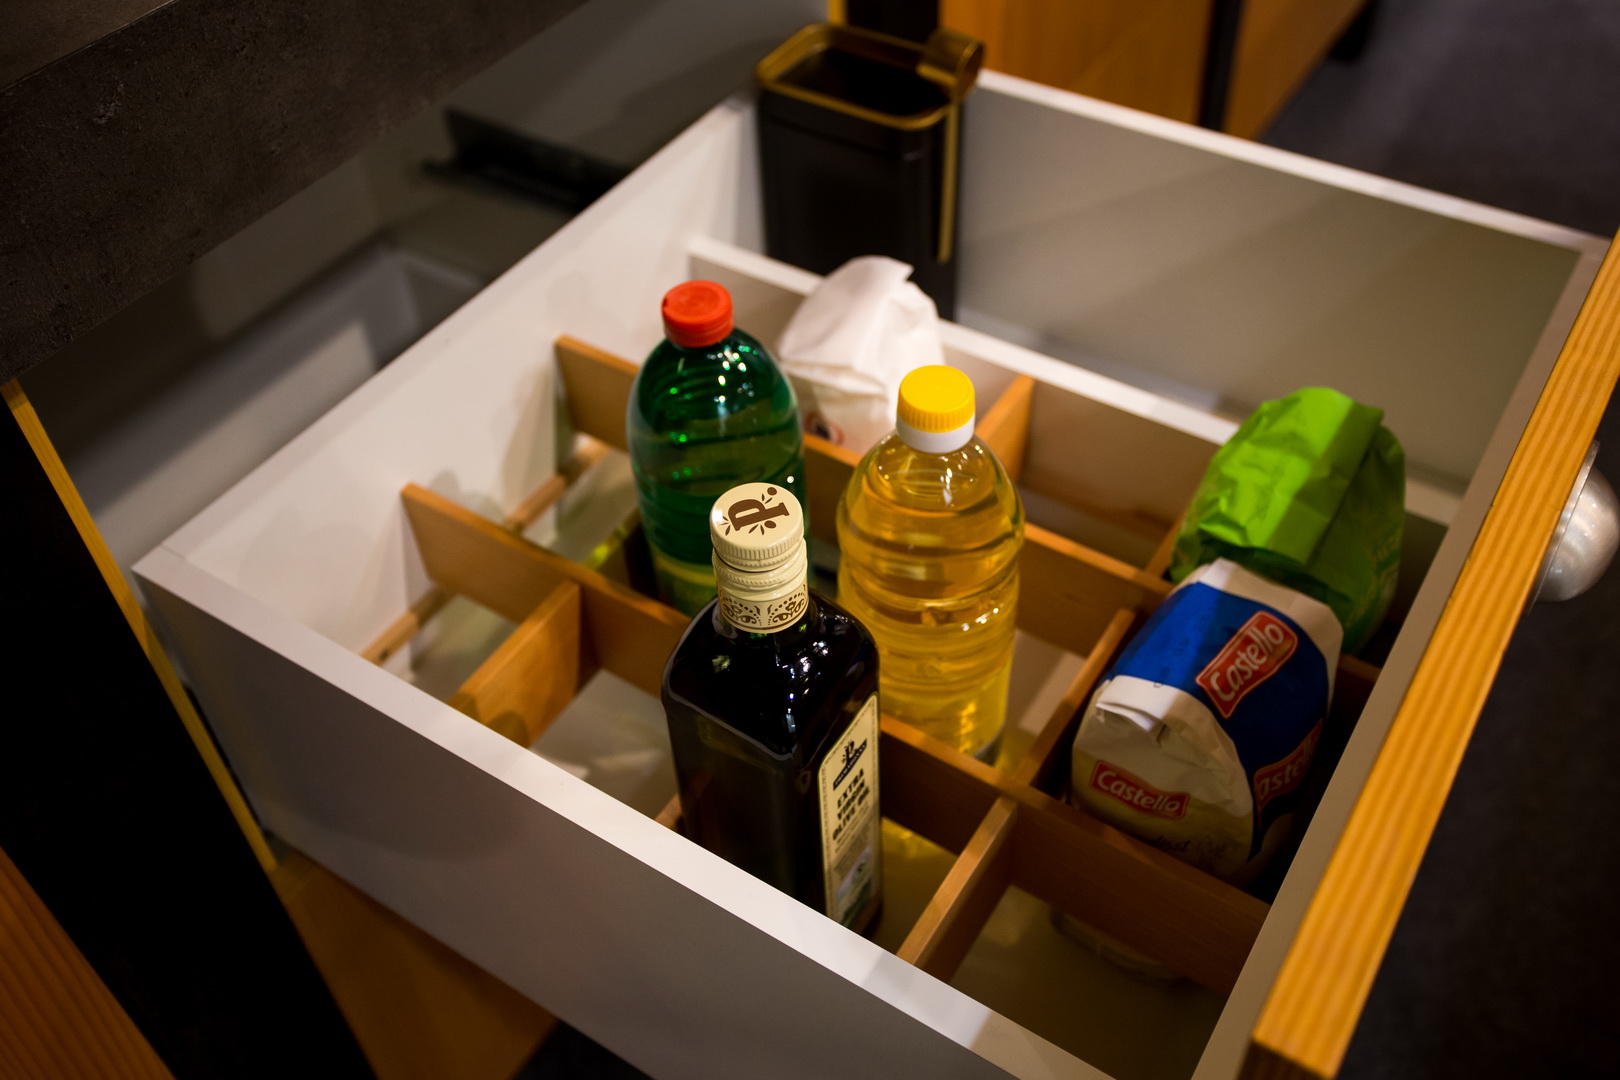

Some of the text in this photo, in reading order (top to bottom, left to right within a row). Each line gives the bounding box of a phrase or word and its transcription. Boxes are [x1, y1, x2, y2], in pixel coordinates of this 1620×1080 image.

[1209, 622, 1285, 702] Castello
[837, 768, 864, 809] EXTRA
[837, 778, 865, 820] VIRGIN
[1096, 769, 1181, 814] Castello
[832, 804, 855, 841] OLIVE
